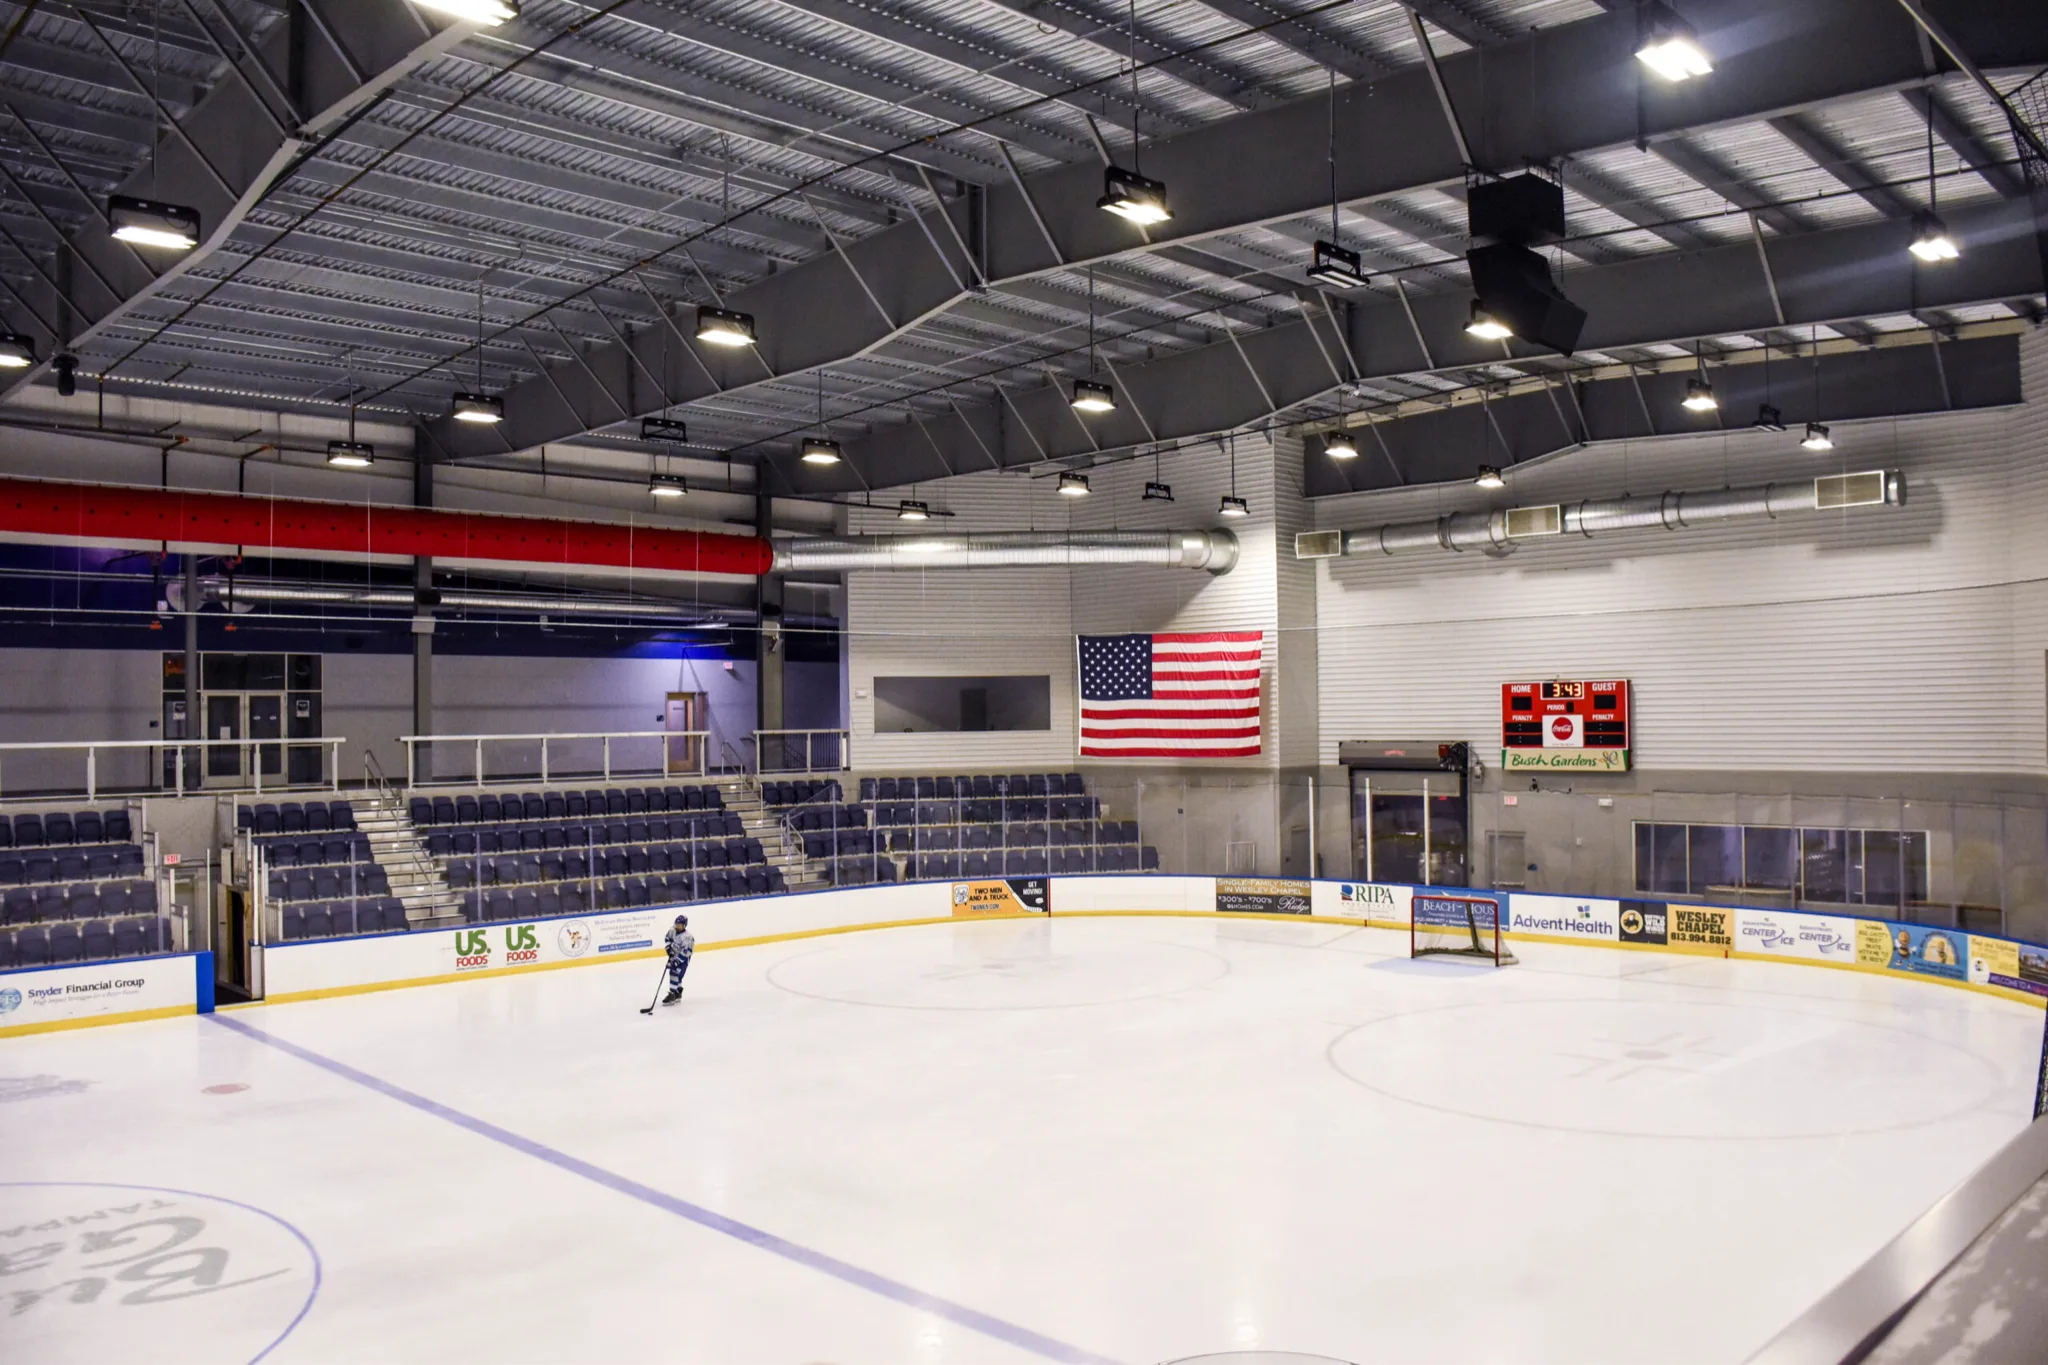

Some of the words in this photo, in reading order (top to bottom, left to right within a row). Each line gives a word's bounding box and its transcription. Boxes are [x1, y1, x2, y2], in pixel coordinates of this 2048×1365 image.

[1511, 685, 1532, 693] HOME
[1553, 683, 1582, 697] 3:43
[1592, 683, 1617, 691] GUEST
[1511, 753, 1549, 766] Busch
[1551, 754, 1597, 767] Gardens
[1217, 878, 1279, 889] SINGLE-FAMILY
[1281, 880, 1310, 889] HOMES
[1234, 886, 1269, 894] WESLEY
[1270, 887, 1304, 896] CHAPEL
[1355, 885, 1395, 904] RIPA
[1423, 900, 1455, 913] BEACH
[1464, 902, 1495, 916] HOUS
[1675, 910, 1726, 924] WESLEY
[1677, 921, 1725, 935] CHAPEL
[1670, 932, 1731, 945] 813.994.8812
[1742, 927, 1776, 938] CENTER
[1780, 937, 1795, 945] ICE
[1799, 932, 1834, 942] CENTER
[1836, 943, 1851, 951] ICE
[456, 954, 488, 967] FOODS
[506, 950, 538, 962] FOODS
[28, 986, 63, 999] Snyder
[66, 980, 112, 993] Financial
[114, 977, 145, 989] Group
